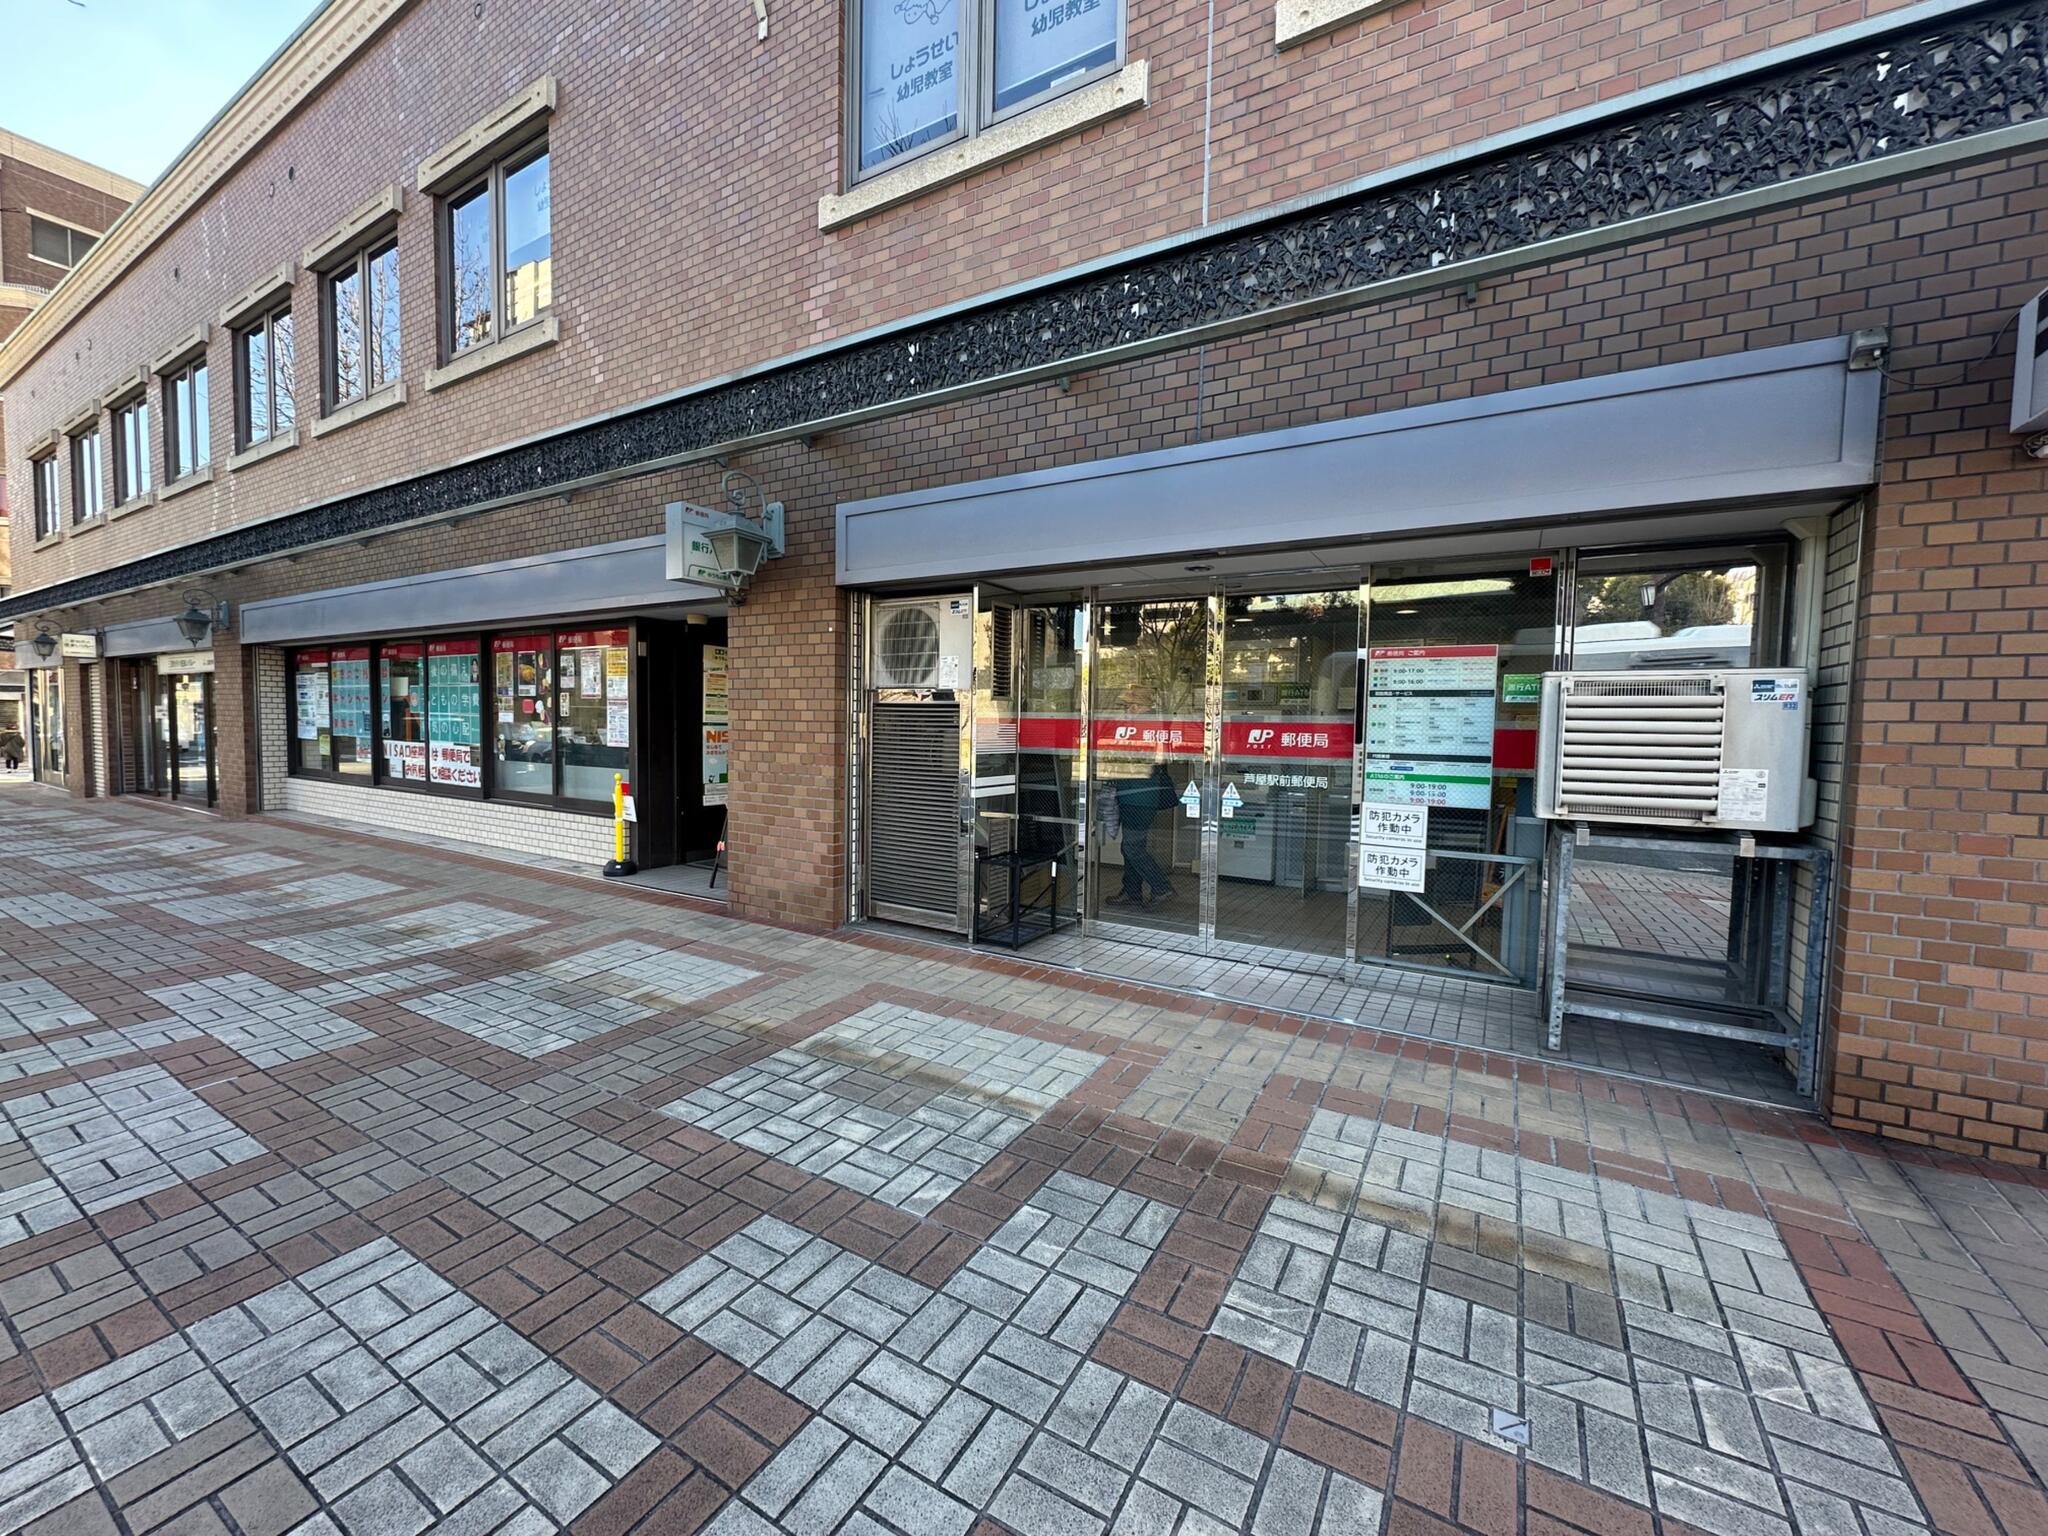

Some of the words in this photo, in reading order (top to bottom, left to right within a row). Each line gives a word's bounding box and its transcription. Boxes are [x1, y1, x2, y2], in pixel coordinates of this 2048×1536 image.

[891, 31, 959, 80] しょうせい
[896, 60, 953, 103] 幼児教室
[1754, 693, 1795, 701] スリムER
[1115, 727, 1136, 739] JP
[1143, 730, 1182, 743] 郵便局
[1248, 729, 1274, 744] JP
[1281, 732, 1329, 748] 郵便局
[1243, 773, 1328, 789] 芦屋駅前郵便局
[1369, 810, 1421, 823] 防犯カメラ
[1377, 822, 1412, 834] 作動中
[1367, 853, 1418, 867] 防犯カメラ
[1375, 865, 1410, 878] 作動中
